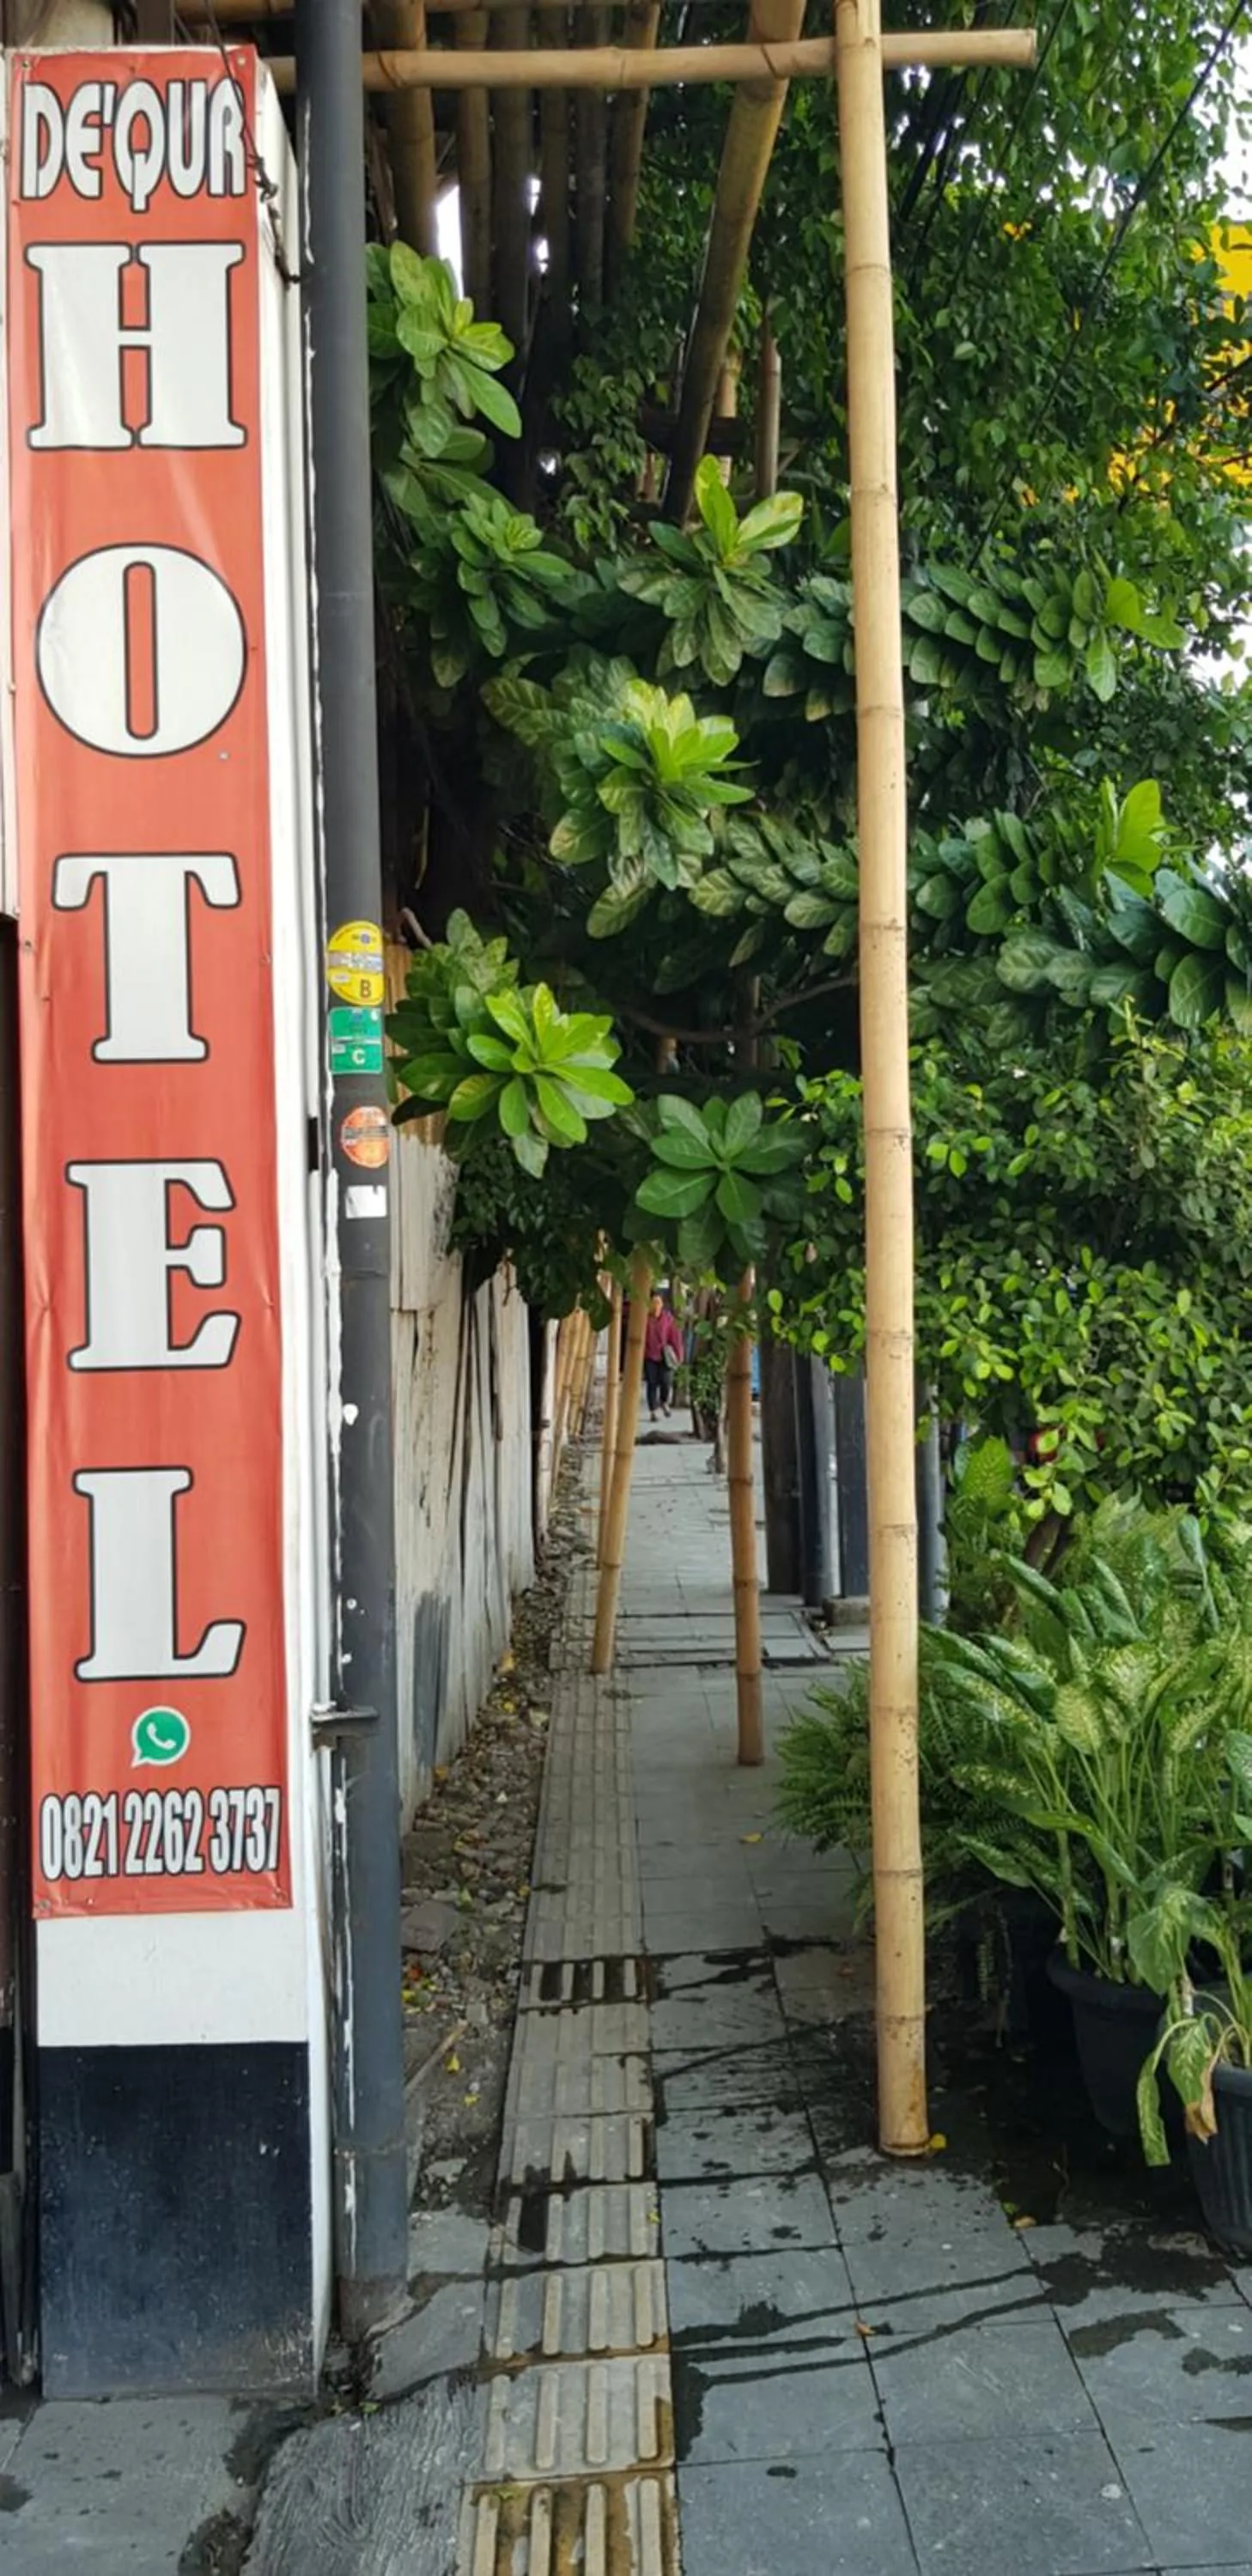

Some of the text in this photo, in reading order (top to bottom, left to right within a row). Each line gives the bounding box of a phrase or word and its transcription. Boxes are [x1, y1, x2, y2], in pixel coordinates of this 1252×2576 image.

[20, 77, 248, 213] DE'QUR
[24, 241, 248, 1681] HOTEL
[360, 978, 372, 999] B
[352, 1048, 366, 1066] C
[40, 1786, 282, 1880] 0821 2262 3737
